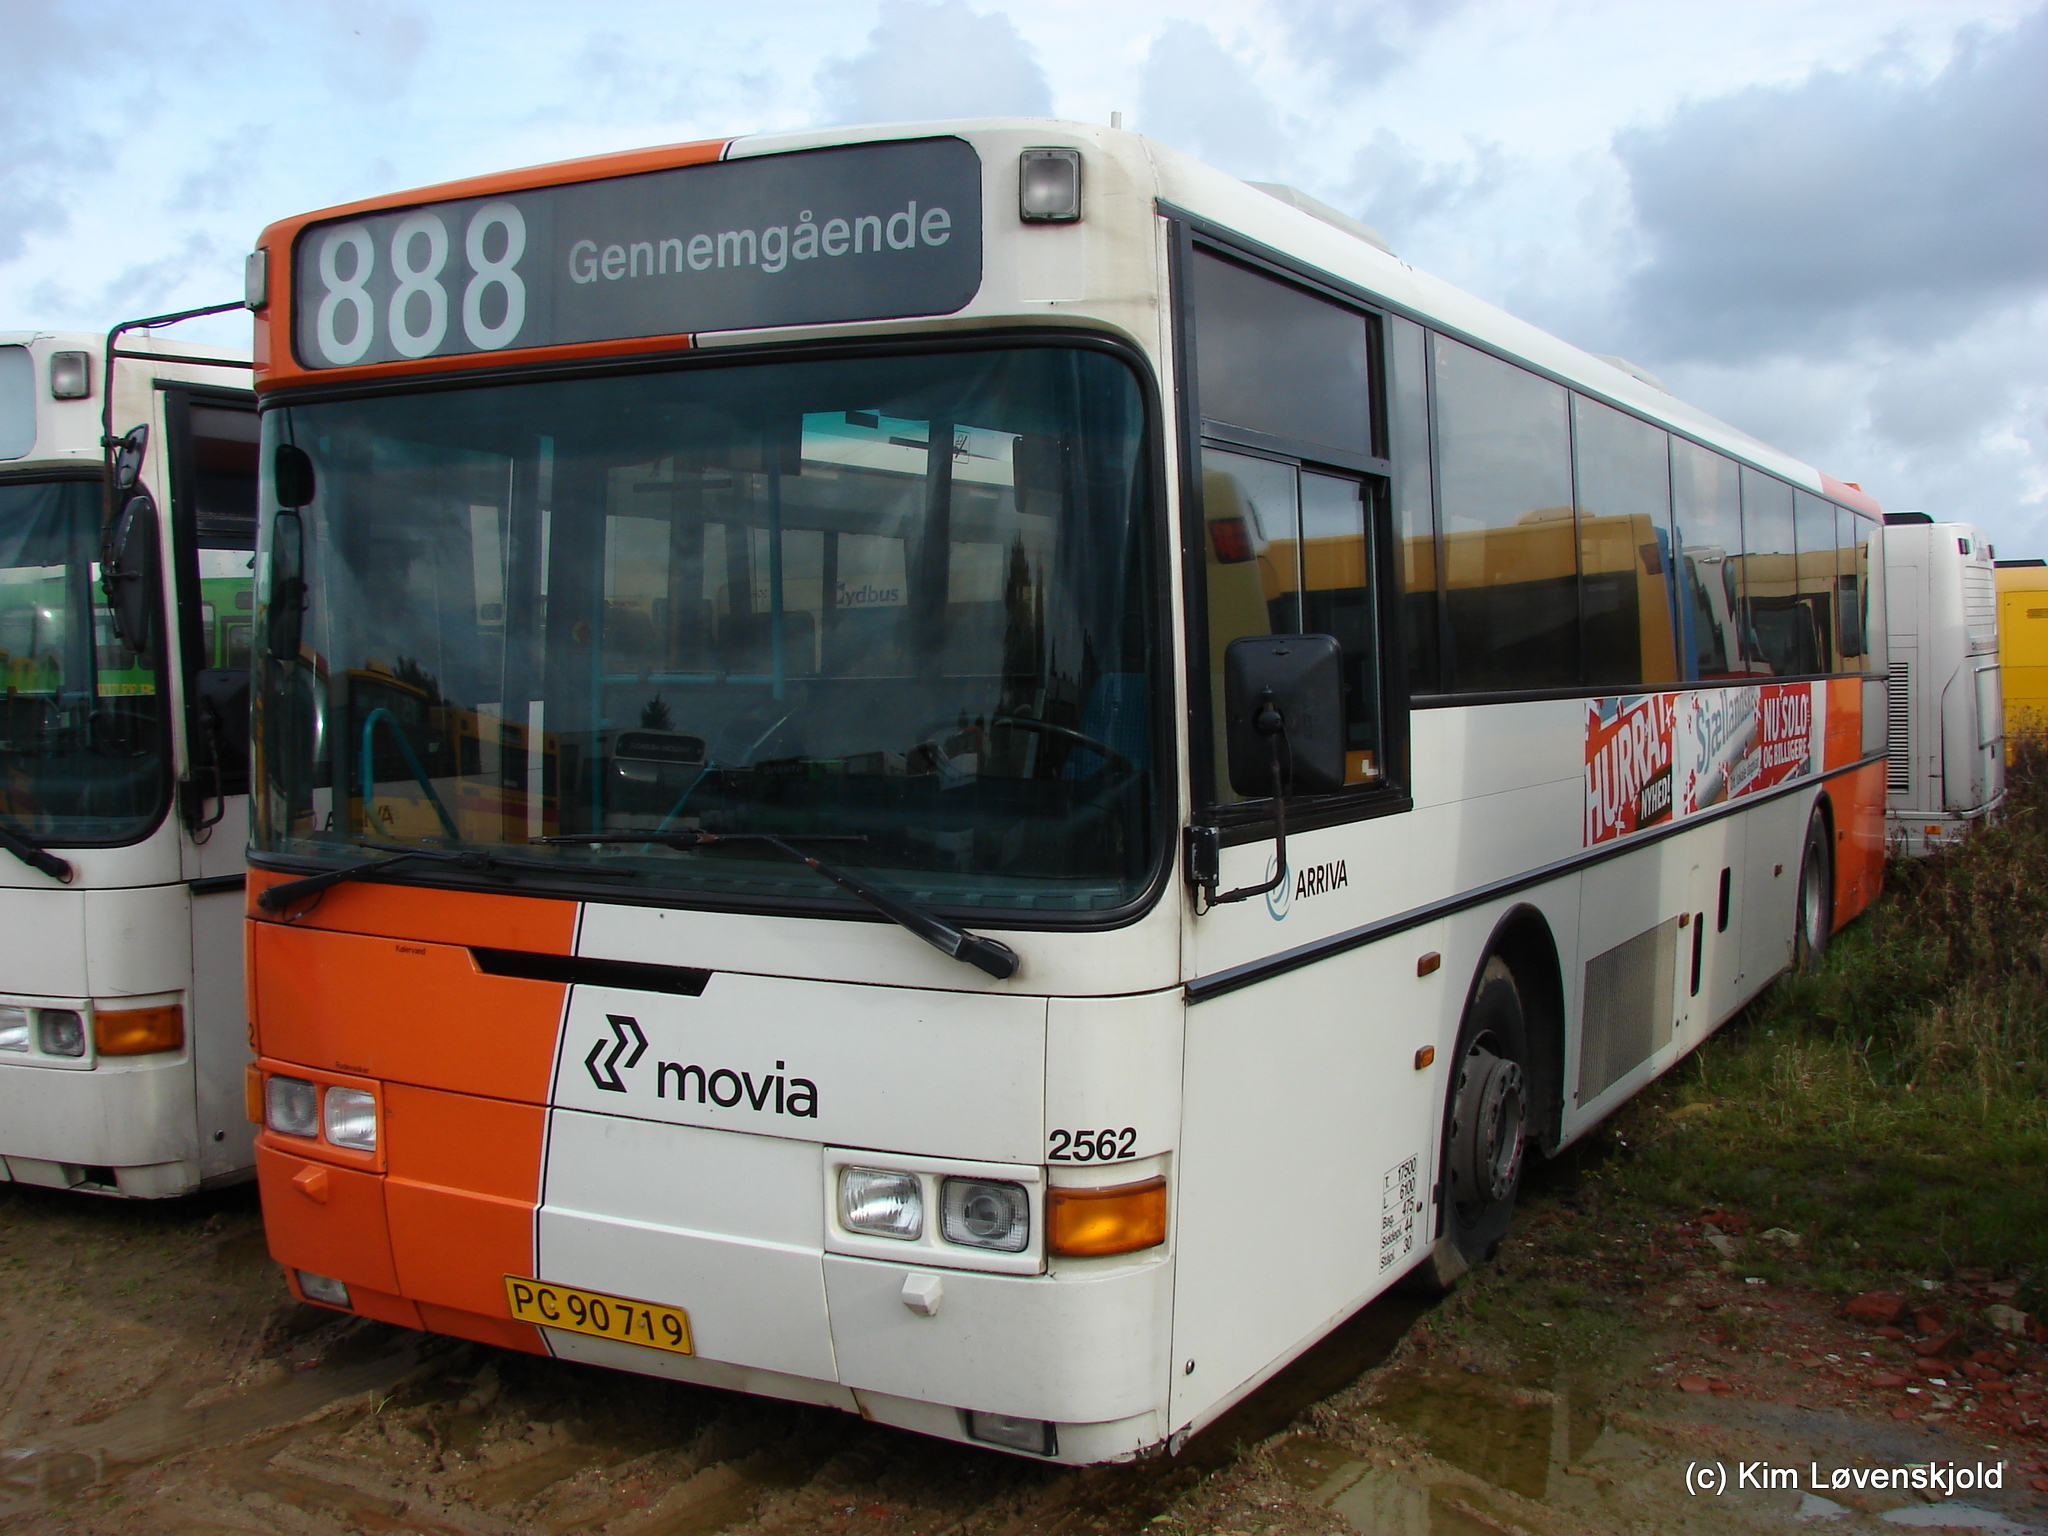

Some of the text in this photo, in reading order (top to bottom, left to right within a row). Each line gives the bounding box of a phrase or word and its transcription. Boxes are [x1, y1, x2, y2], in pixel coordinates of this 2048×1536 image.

[316, 200, 952, 366] 888 Gennemgående
[1763, 697, 1780, 743] NU
[1781, 693, 1807, 739] SOLO
[1585, 694, 1668, 846] HURRA!
[1763, 745, 1774, 769] OG
[1640, 774, 1671, 821] NYHED!
[1295, 859, 1348, 901] ARRIVA
[657, 1060, 819, 1119] movia
[1048, 1127, 1137, 1162] 2562
[1397, 1156, 1417, 1182] 17500
[1399, 1176, 1416, 1200] 6100
[1401, 1195, 1414, 1215] 475
[1404, 1215, 1413, 1233] 44
[1402, 1234, 1413, 1254] 30
